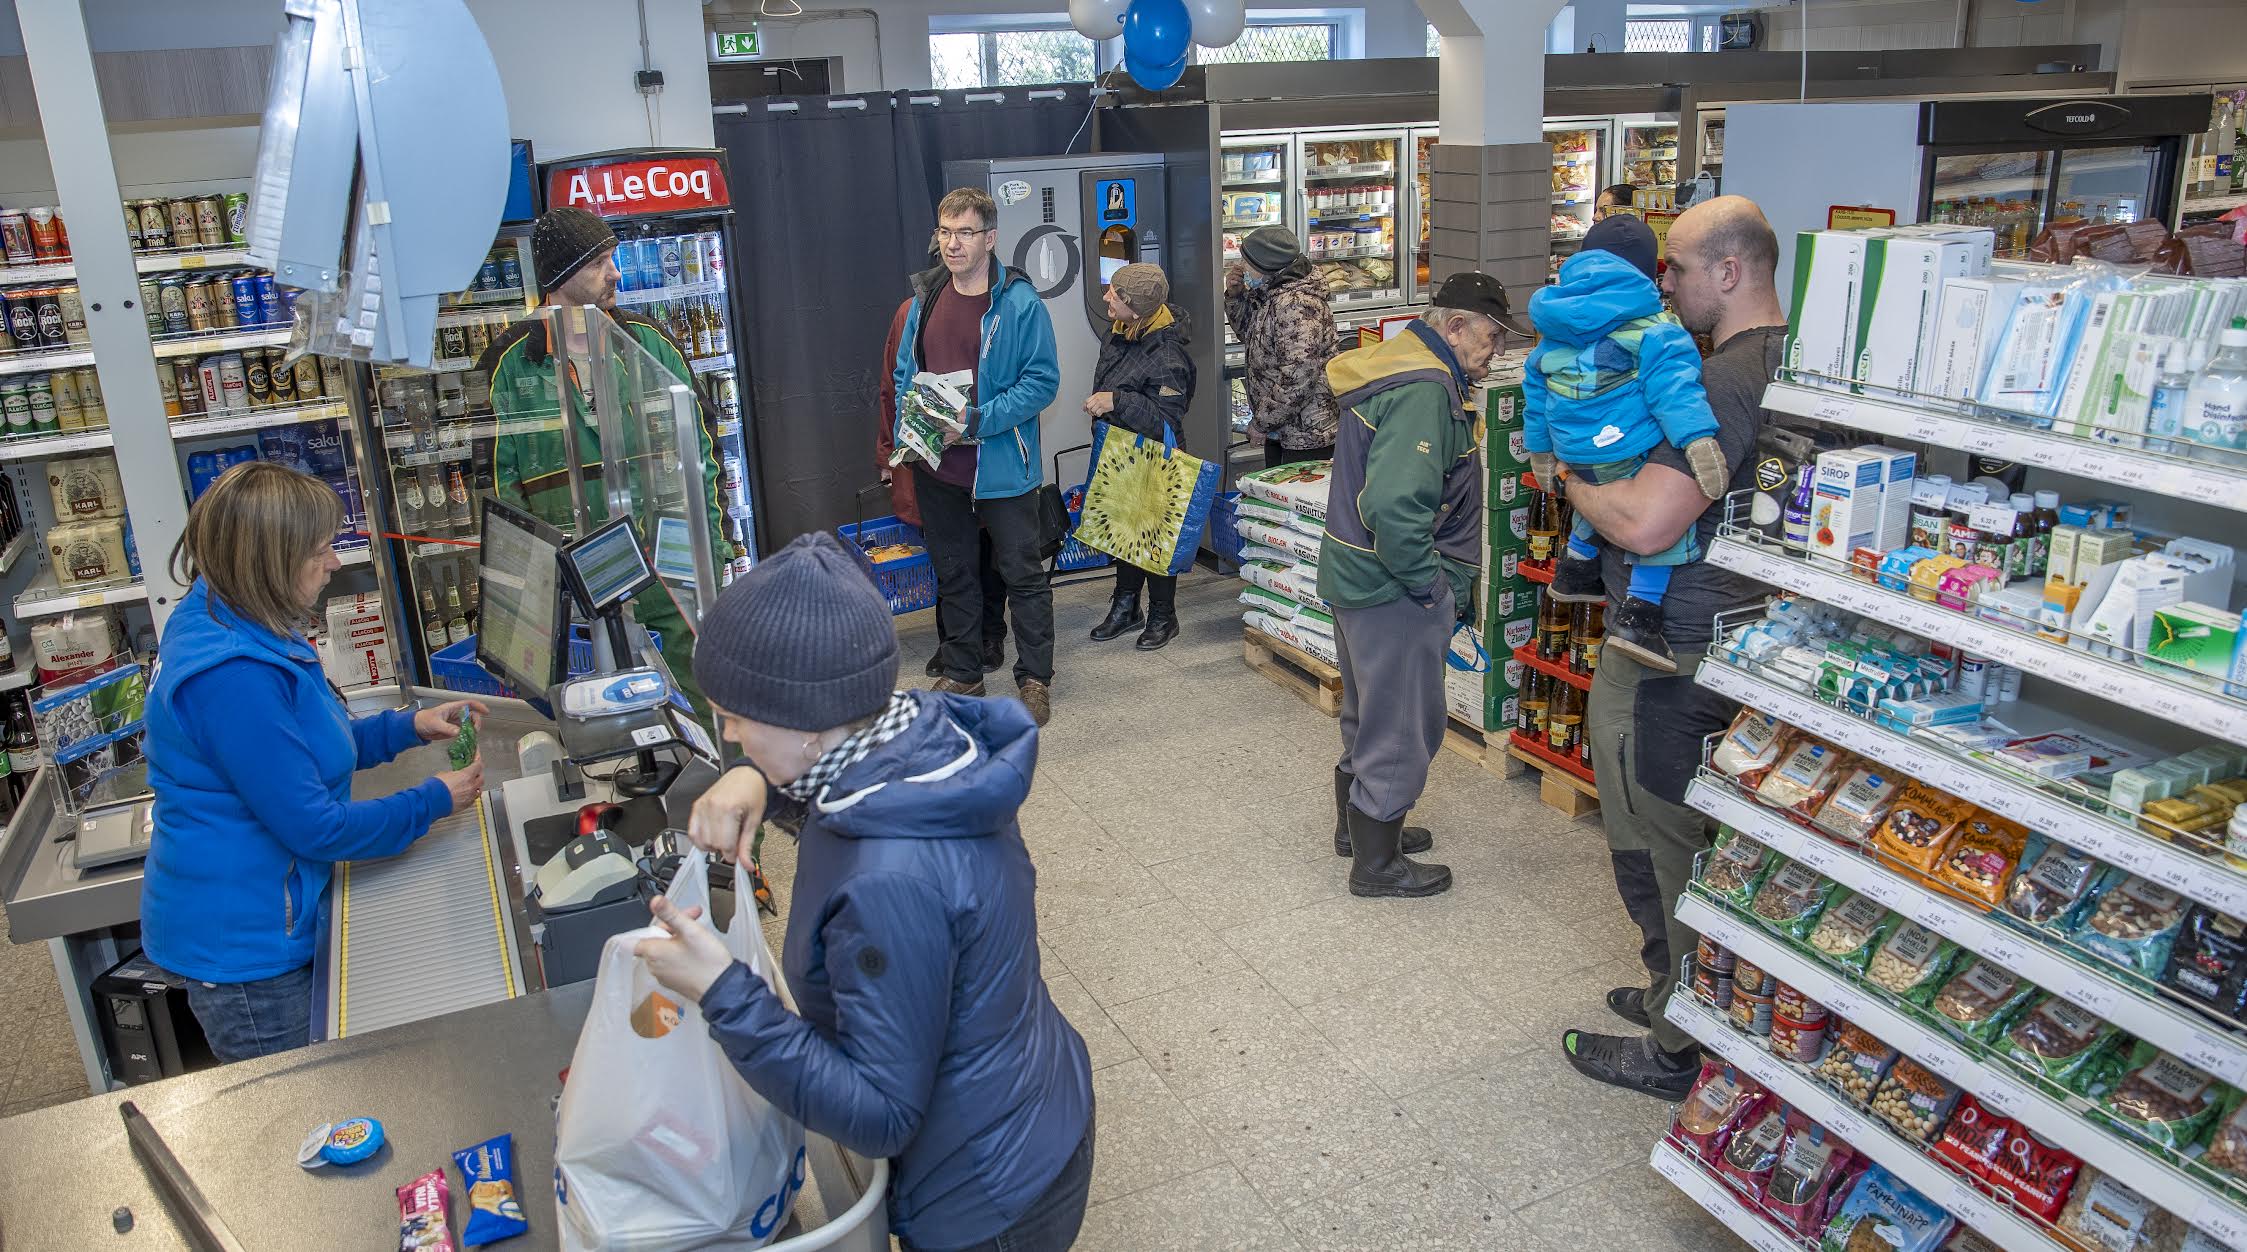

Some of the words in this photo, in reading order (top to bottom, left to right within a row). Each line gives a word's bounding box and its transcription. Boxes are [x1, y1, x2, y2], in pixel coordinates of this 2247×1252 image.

[2065, 115, 2089, 123] TEFCOLD
[568, 166, 714, 206] A.LeCoq
[237, 295, 254, 303] saku
[261, 292, 279, 300] saku
[41, 315, 62, 326] ROCK
[169, 311, 185, 319] KARL
[13, 318, 34, 328] ROCK
[2204, 402, 2231, 412] Hand
[308, 434, 339, 449] saku
[425, 429, 434, 451] ICE
[1416, 445, 1430, 453] TECH
[1821, 466, 1851, 480] SIROP
[1270, 491, 1289, 503] BIOLAN
[74, 500, 99, 510] KARL
[1267, 535, 1288, 547] BIOLAN
[77, 566, 102, 576] KARL
[1273, 580, 1292, 593] BIOLAN
[51, 650, 95, 663] Alexander
[1855, 898, 1878, 914] INDIA
[1907, 927, 1929, 945] INDIA
[131, 1053, 147, 1061] APC
[2013, 1176, 2055, 1205] PEANUTS
